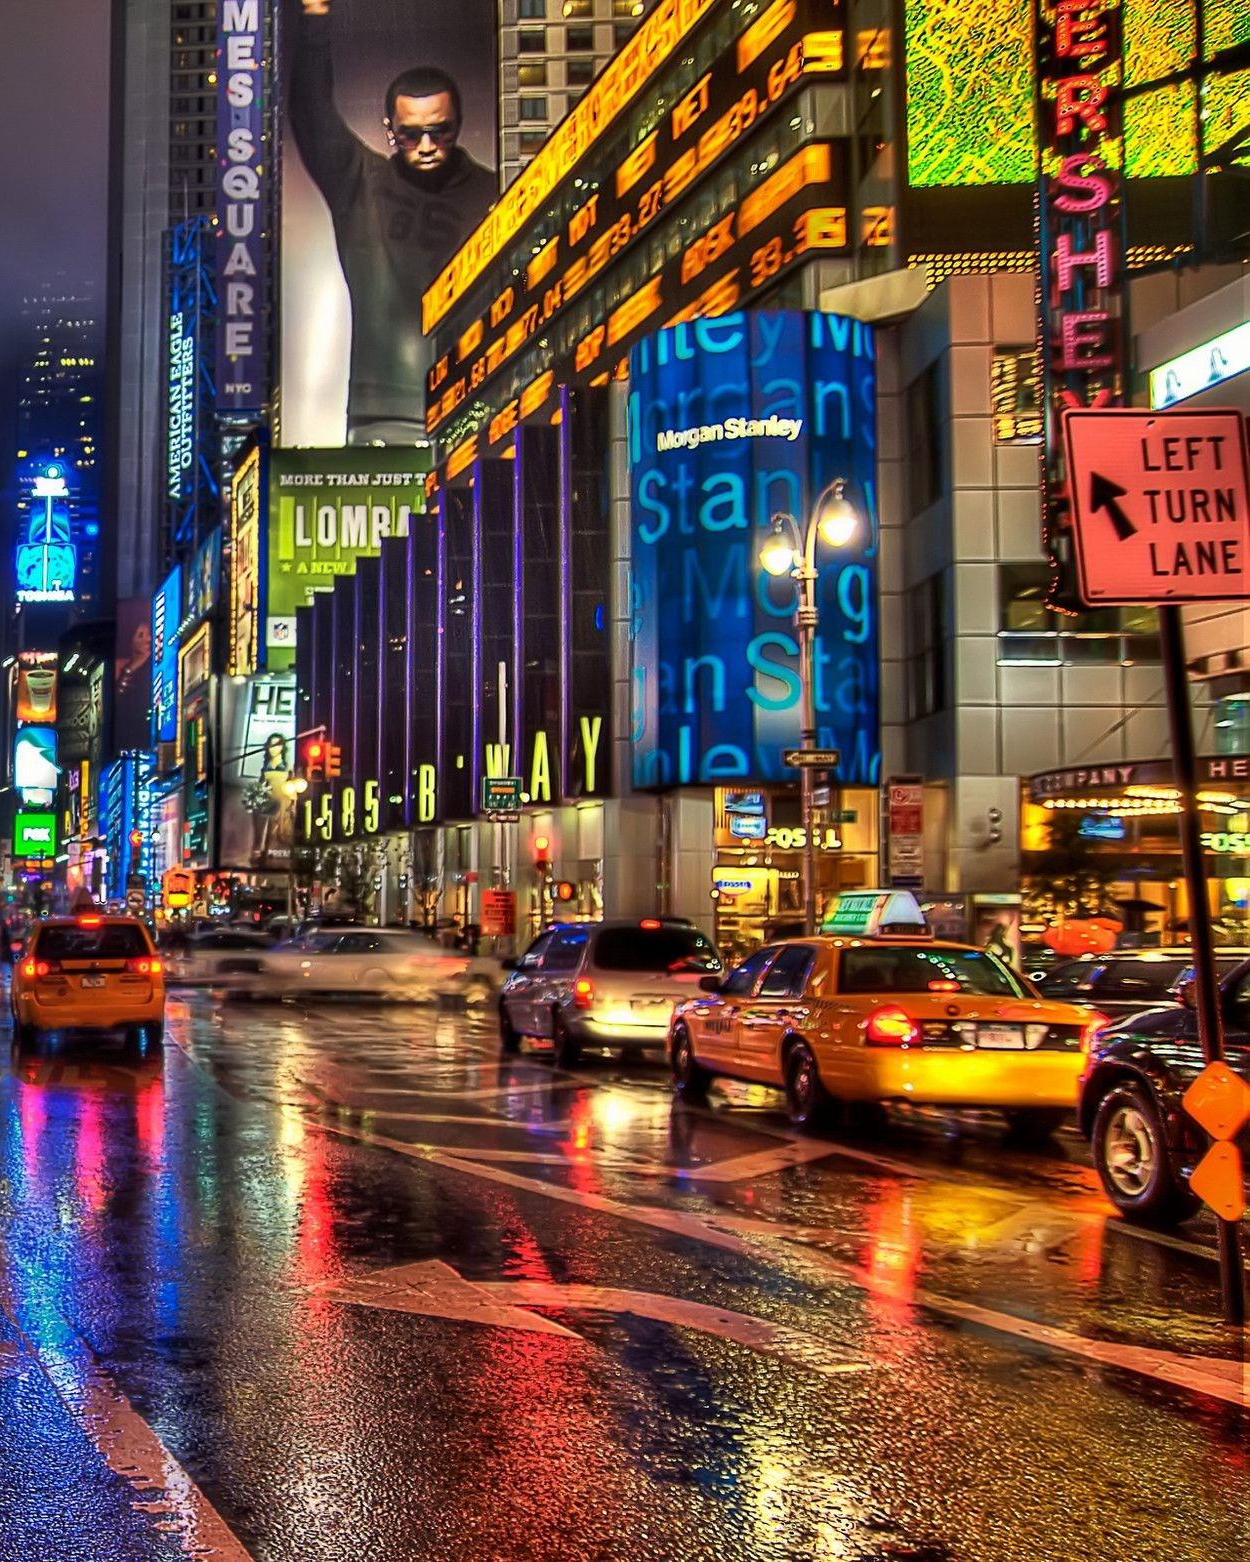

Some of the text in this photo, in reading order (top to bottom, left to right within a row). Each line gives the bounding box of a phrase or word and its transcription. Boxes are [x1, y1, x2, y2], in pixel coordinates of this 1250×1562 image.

[223, 129, 259, 356] SQUARE
[168, 311, 183, 498] AMERICAN EAGLE
[181, 336, 195, 470] OUTFITTERS
[224, 383, 252, 394] NYC
[656, 415, 803, 453] Morgan Stanley
[1141, 436, 1225, 472] LEFT
[279, 473, 324, 487] MORE
[327, 473, 370, 486] THAN
[371, 473, 412, 486] JUST
[1143, 487, 1238, 524] TURN
[295, 504, 427, 549] LOMBA
[310, 562, 349, 575] NEW
[1149, 540, 1243, 577] LANE
[1208, 760, 1249, 777] HE
[304, 779, 379, 841] 1585
[22, 827, 51, 842] FOX
